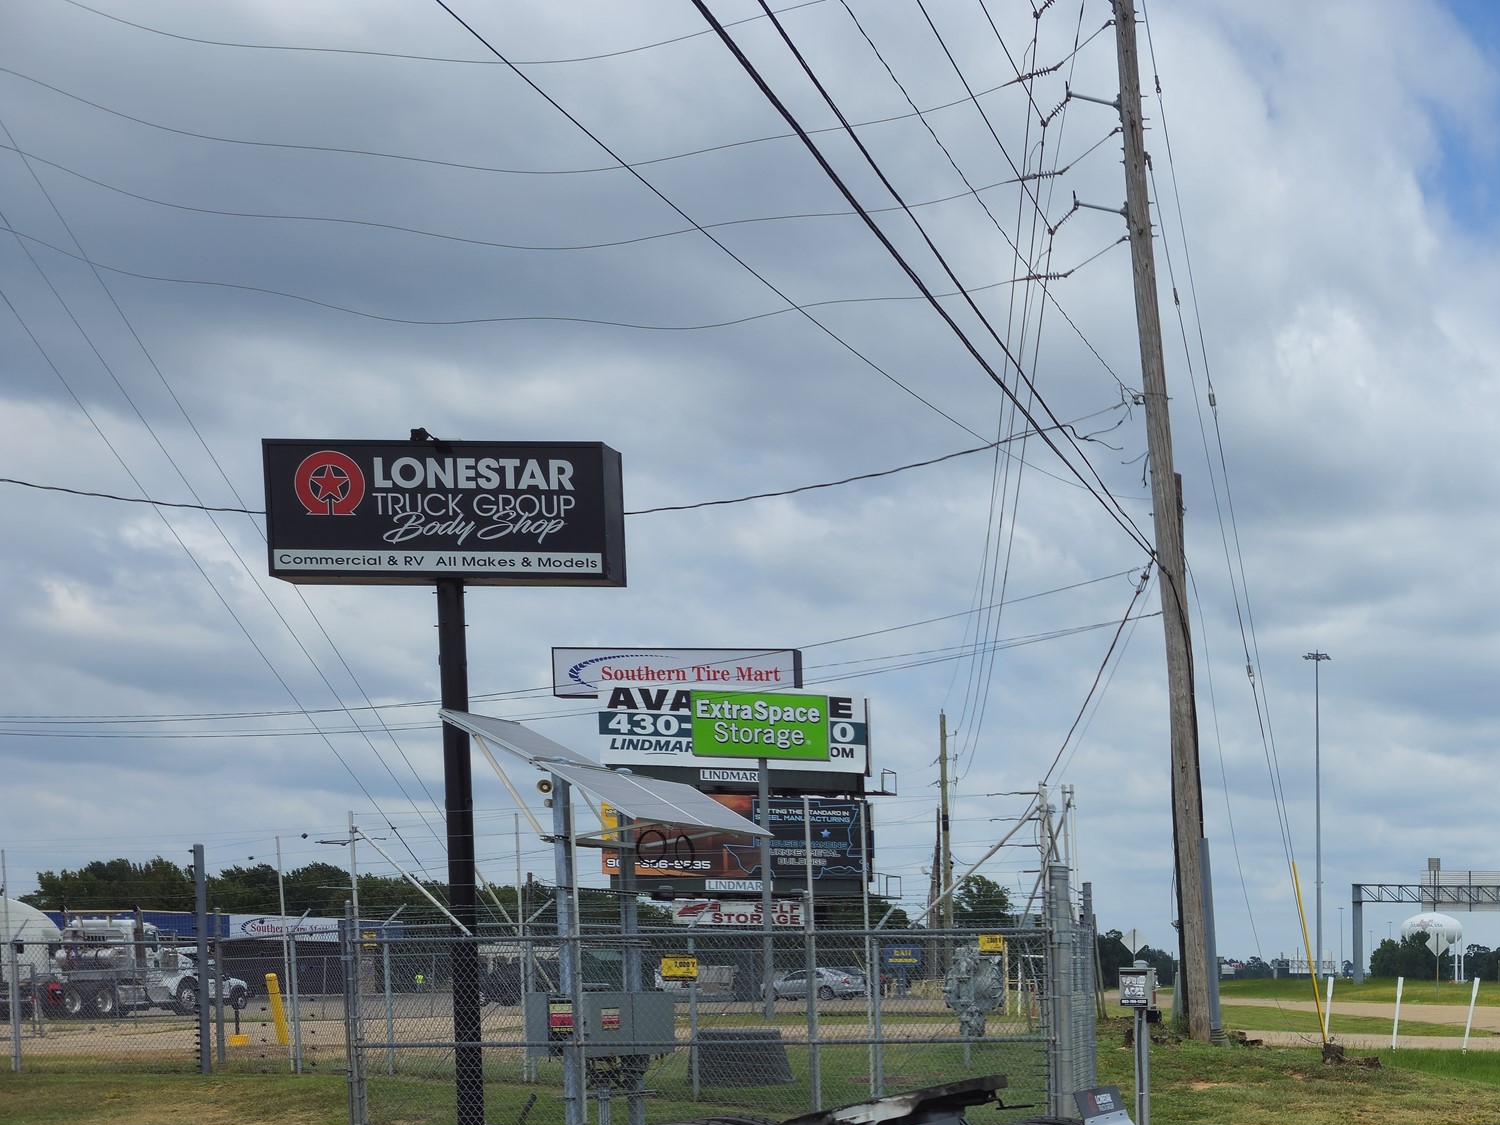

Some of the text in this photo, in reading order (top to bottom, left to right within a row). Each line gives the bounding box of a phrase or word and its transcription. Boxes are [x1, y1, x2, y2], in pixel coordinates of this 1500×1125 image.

[373, 457, 575, 490] LONESTAR
[372, 492, 575, 518] TRUCK GROUP
[383, 507, 568, 545] Body Shop
[279, 553, 598, 569] Commercial & RV All Makes & Models
[601, 665, 781, 682] Southern Tire Mart
[714, 722, 804, 749] Storage
[702, 770, 760, 781] LINDMAR
[769, 848, 808, 856] URNKEY
[800, 840, 848, 848] FNANCING
[708, 880, 763, 890] LINDMAR
[250, 922, 290, 933] Southen
